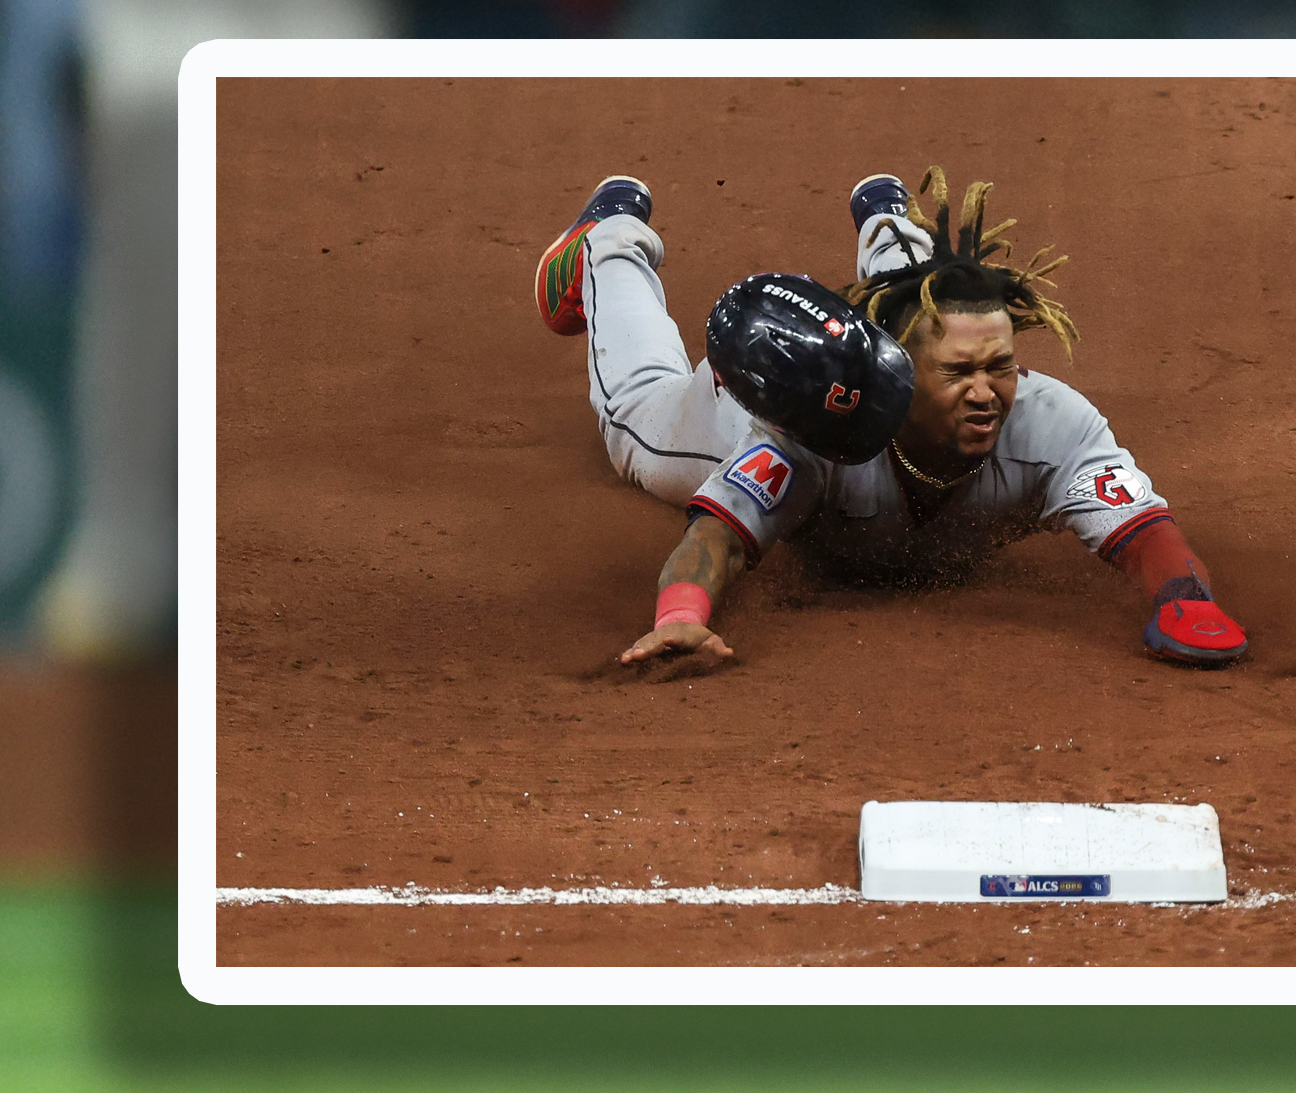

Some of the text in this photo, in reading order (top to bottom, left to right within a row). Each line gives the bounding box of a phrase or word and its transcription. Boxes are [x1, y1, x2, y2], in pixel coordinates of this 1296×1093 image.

[762, 284, 829, 322] STRAUSS
[730, 470, 773, 507] Marathon
[738, 450, 789, 498] M
[1027, 881, 1058, 892] ALCS
